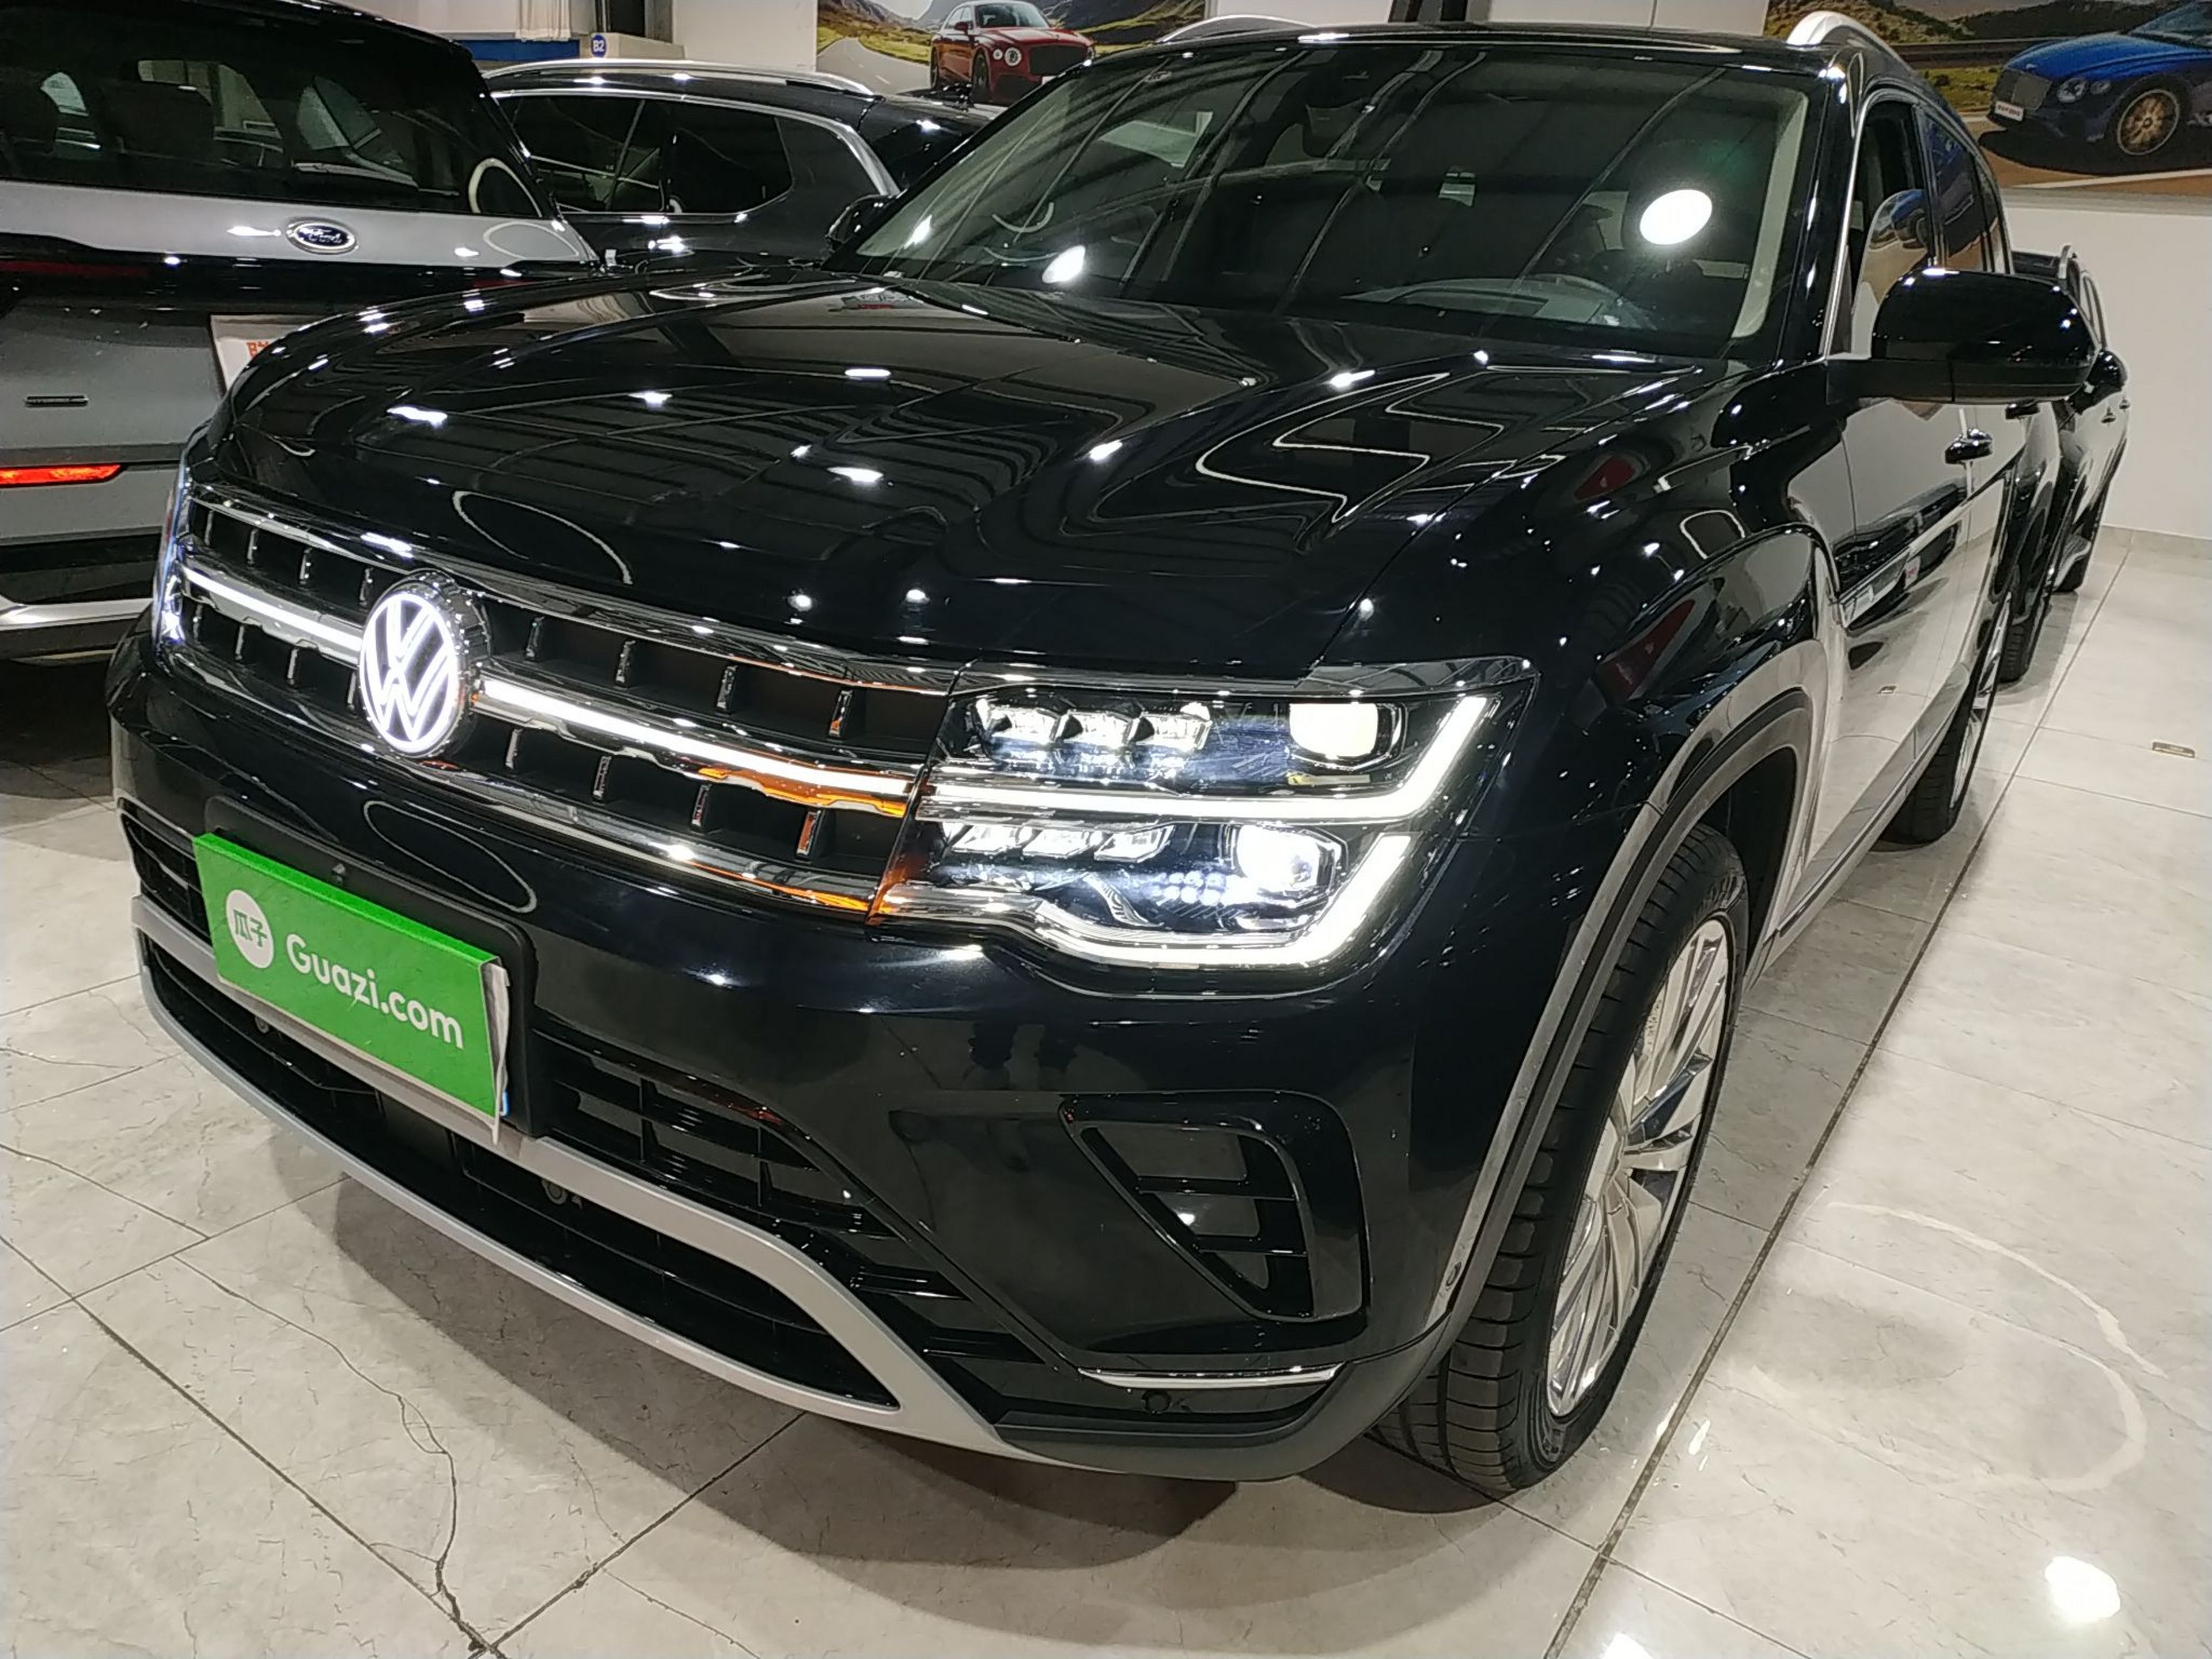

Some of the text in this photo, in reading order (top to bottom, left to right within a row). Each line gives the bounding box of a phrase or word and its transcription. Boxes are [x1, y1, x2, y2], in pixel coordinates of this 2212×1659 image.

[593, 40, 604, 52] B2
[233, 909, 268, 948] 瓜子
[286, 933, 463, 1050] Guazi.com
